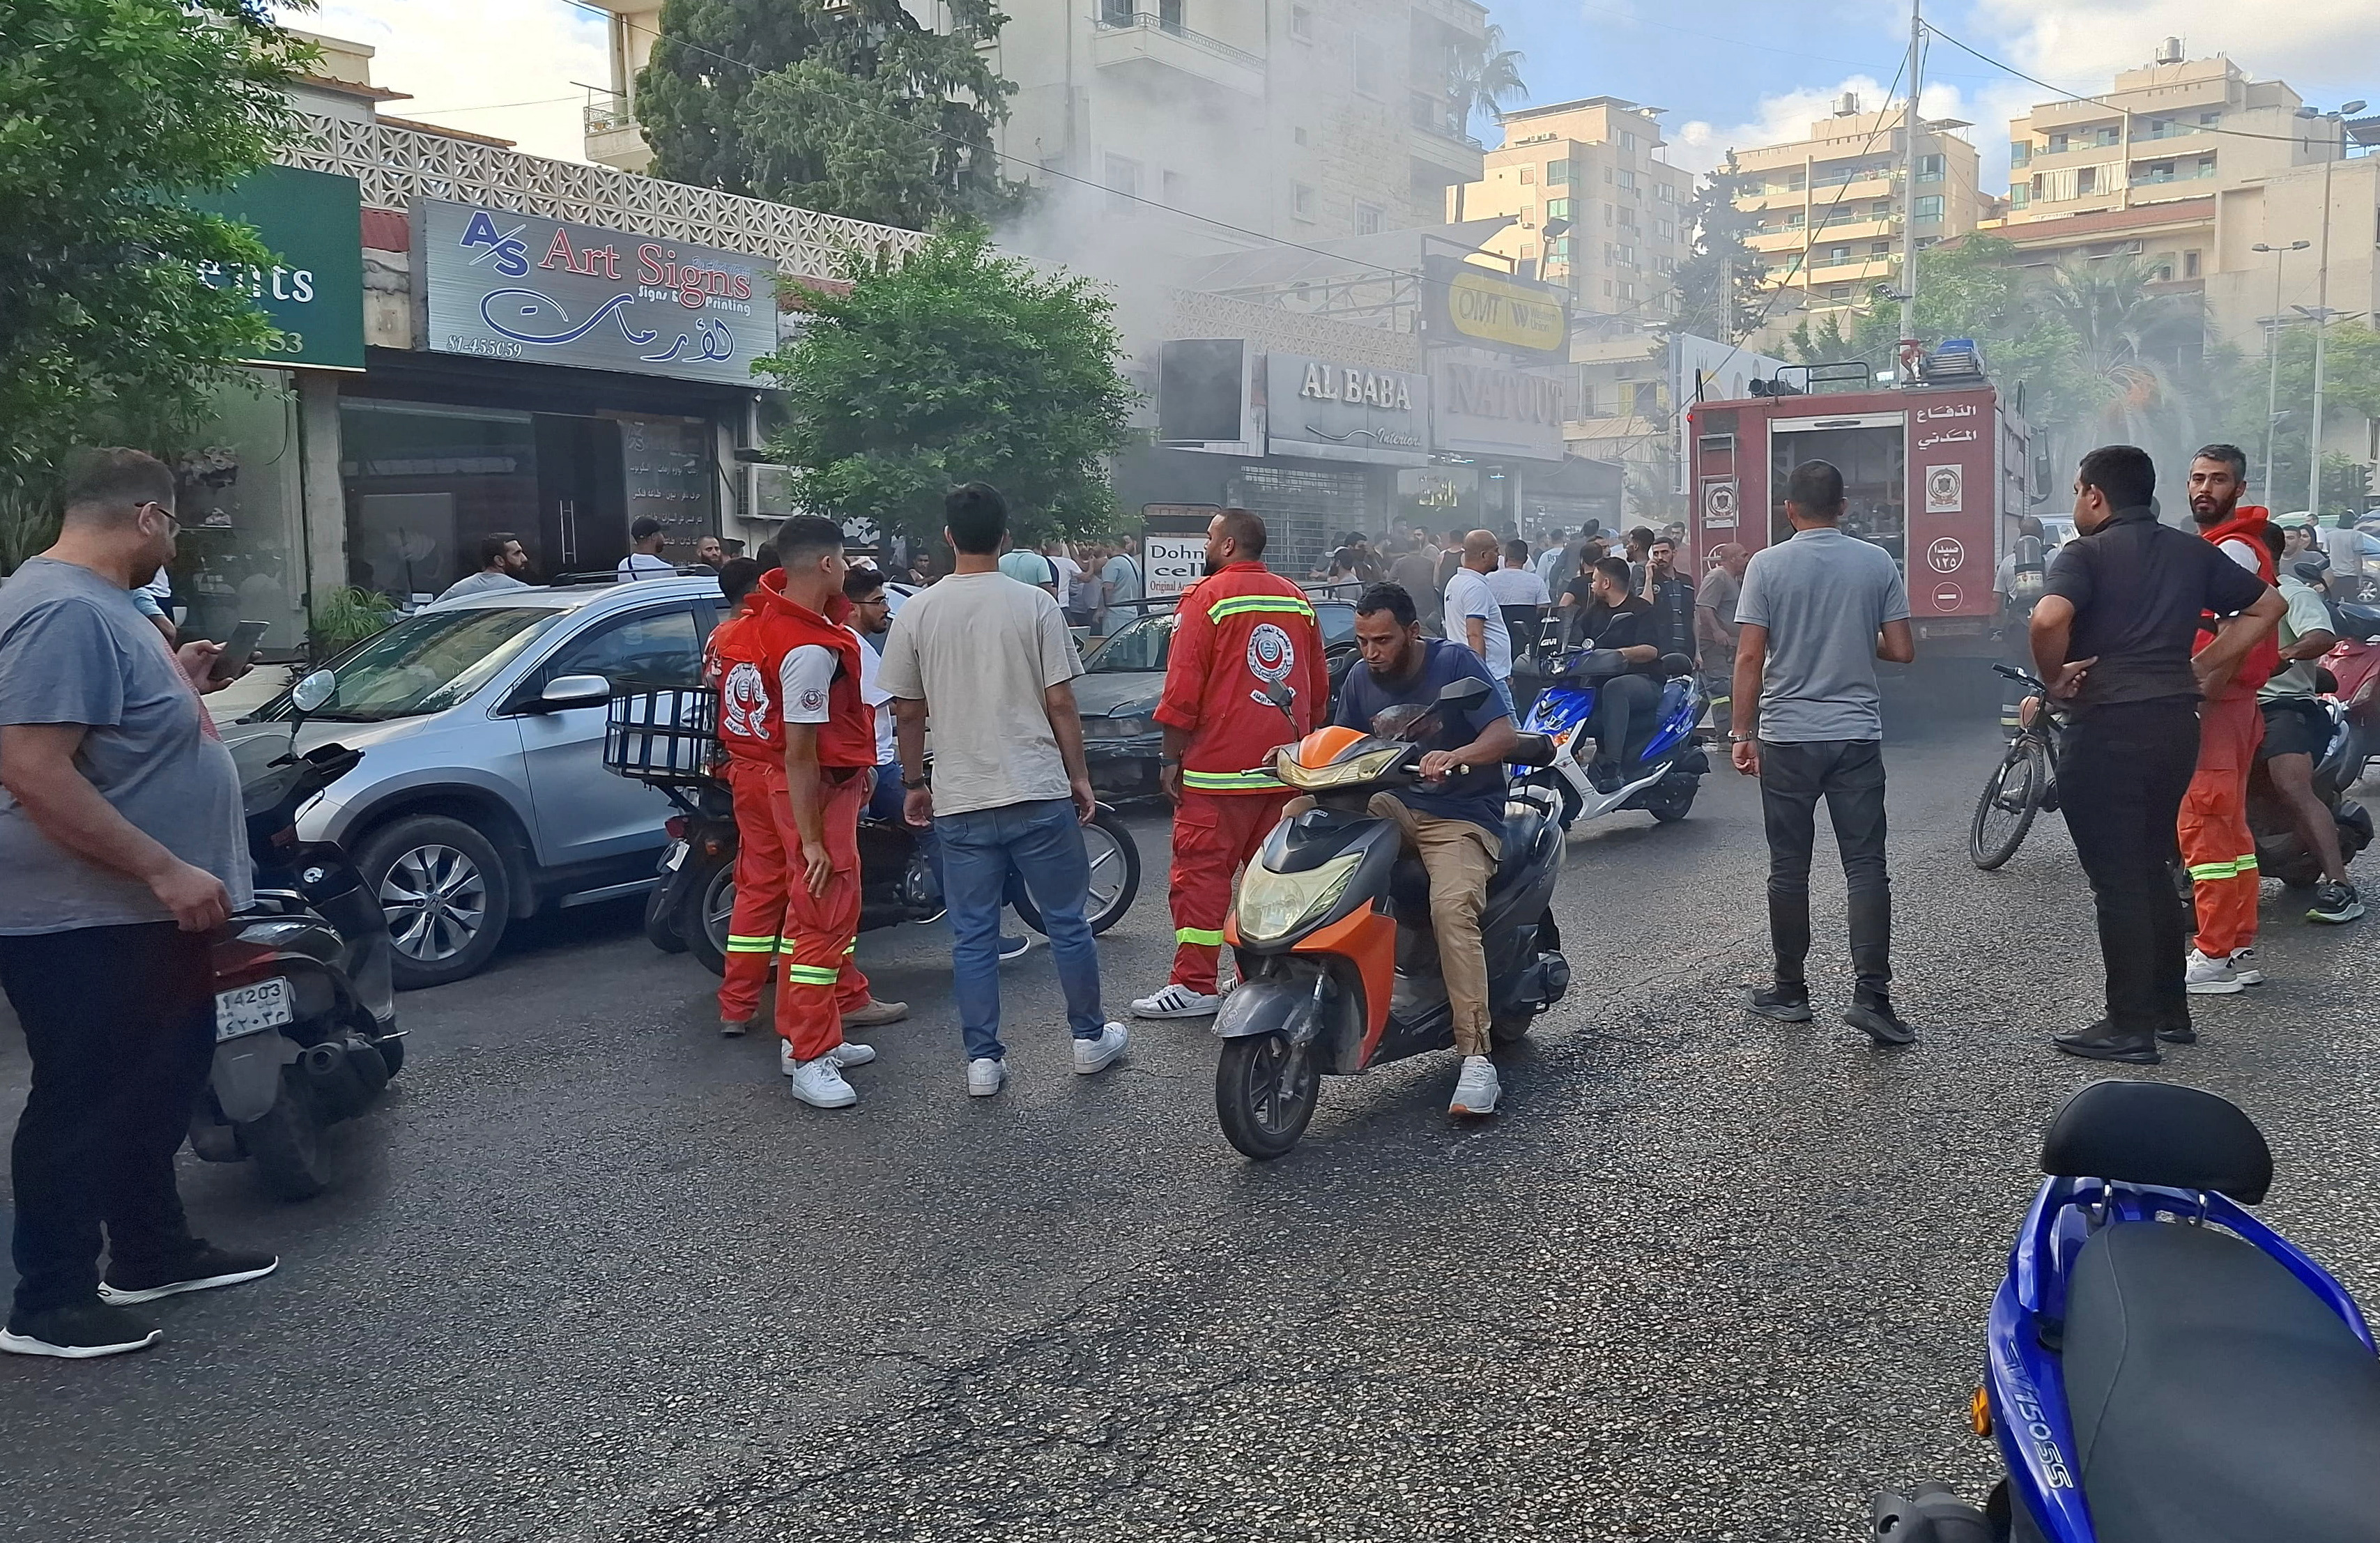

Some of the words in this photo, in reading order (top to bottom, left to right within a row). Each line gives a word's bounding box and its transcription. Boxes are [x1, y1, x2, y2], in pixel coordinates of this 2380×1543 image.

[537, 227, 622, 279] Art
[637, 243, 752, 309] Signs
[638, 284, 668, 302] Signs
[705, 295, 751, 316] Printing
[1458, 291, 1502, 325] OMT
[447, 335, 522, 358] 81-455059
[1300, 362, 1339, 400] AL
[1343, 368, 1413, 410] BABA
[1917, 405, 1976, 423] الدفاع
[1917, 428, 1977, 450] المدني
[1933, 545, 1959, 557] صيدا
[1935, 557, 1957, 568] ١٢٥
[1150, 581, 1176, 594] Original
[1540, 638, 1558, 646] GIVI
[222, 983, 282, 1010] 14203
